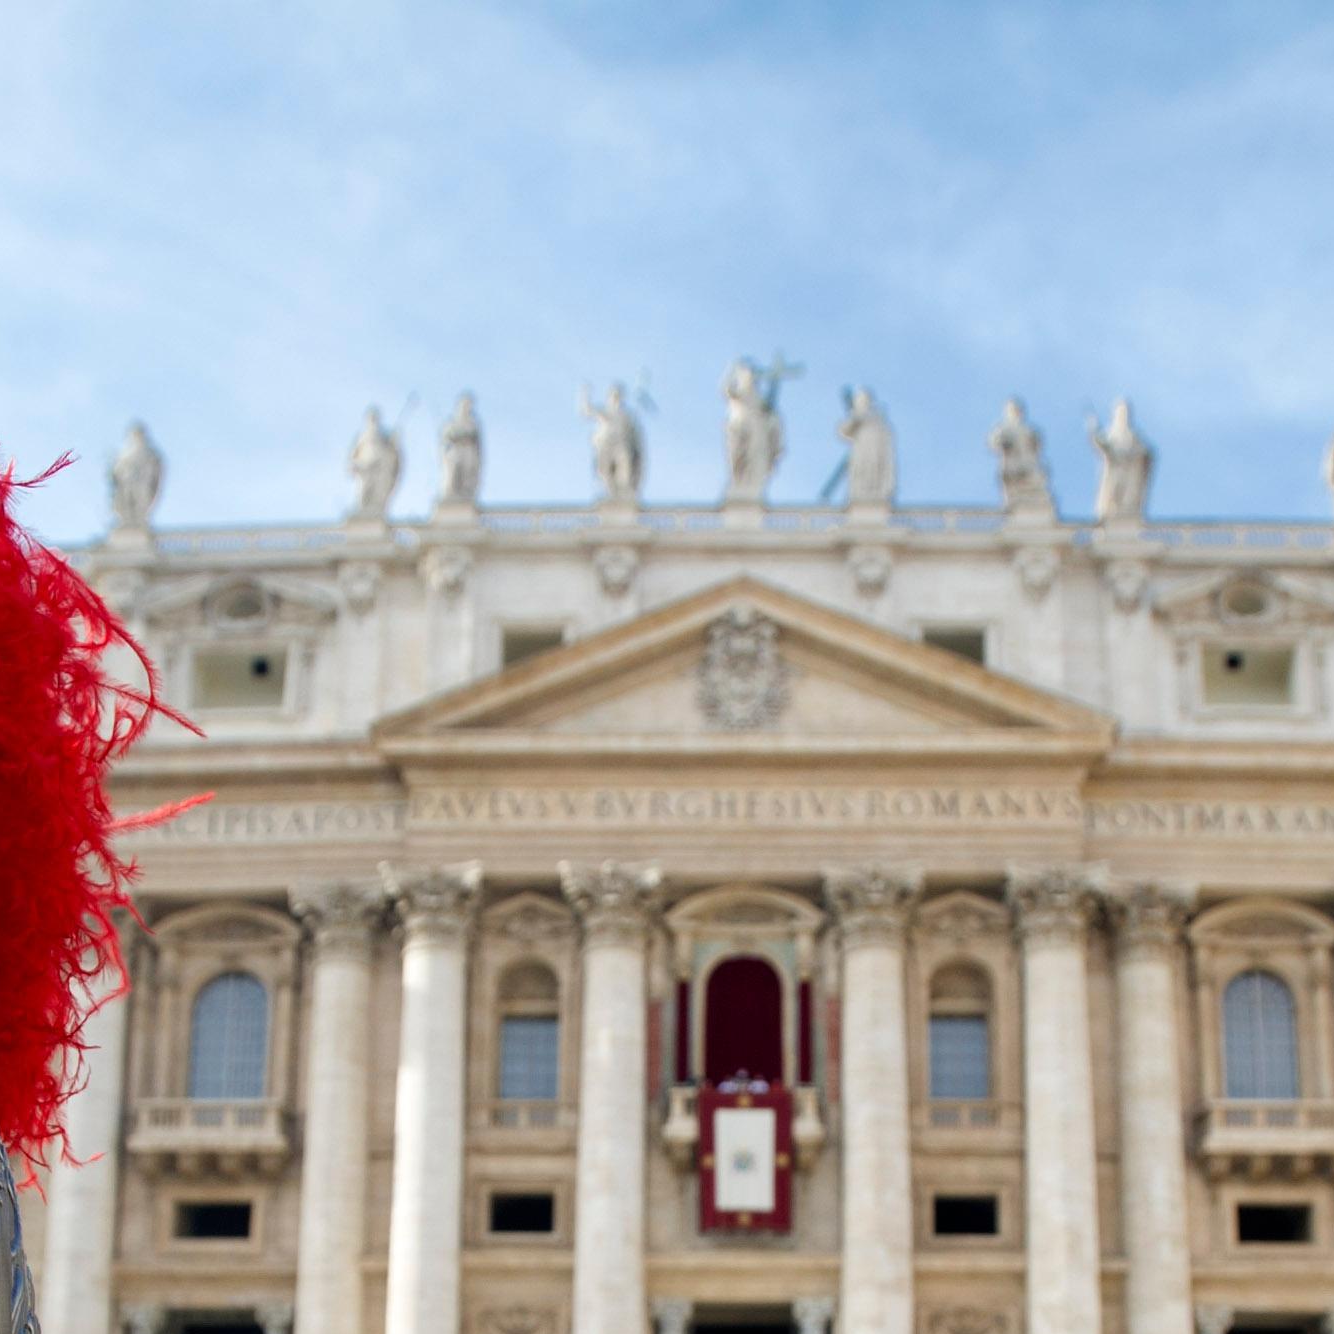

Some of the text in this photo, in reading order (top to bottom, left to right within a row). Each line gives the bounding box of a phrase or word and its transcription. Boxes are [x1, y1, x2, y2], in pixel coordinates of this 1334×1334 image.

[410, 789, 549, 818] PAVLVS
[593, 789, 855, 819] BVRGHESIVS
[866, 789, 1081, 819] ROMANVS
